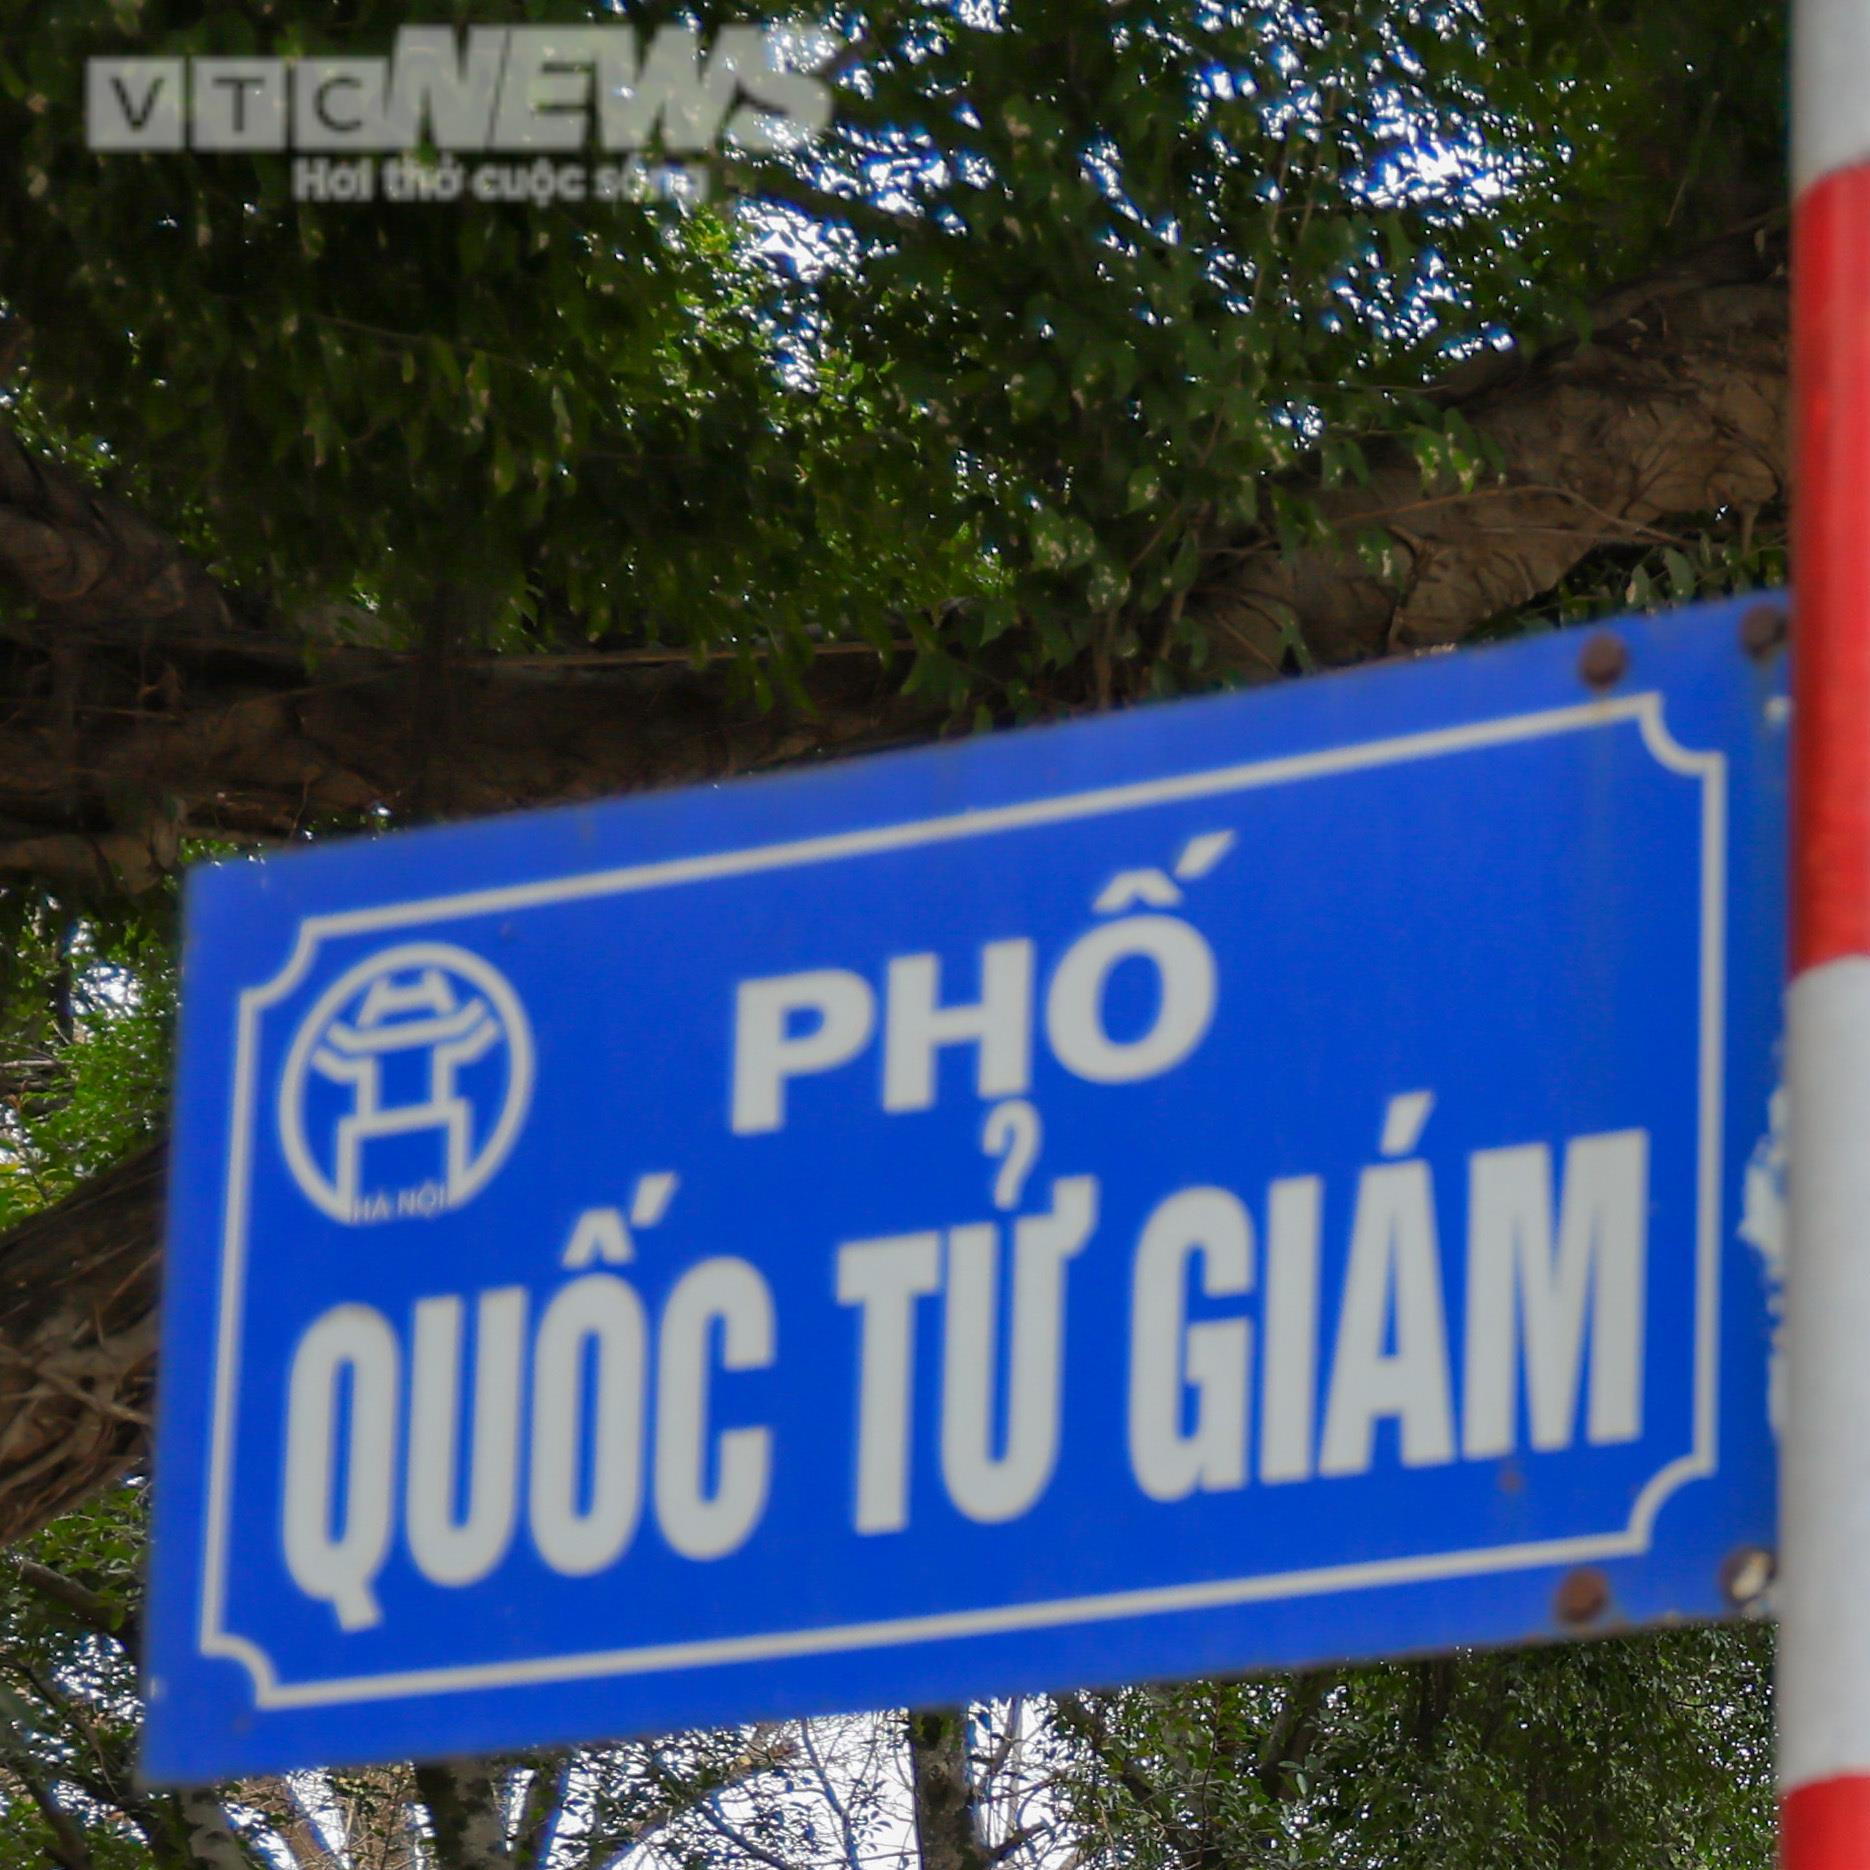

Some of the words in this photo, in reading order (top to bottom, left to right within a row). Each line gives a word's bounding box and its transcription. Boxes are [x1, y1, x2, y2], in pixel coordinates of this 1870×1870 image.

[730, 829, 1234, 1135] PHỐ
[281, 1172, 776, 1632] QUỐC
[836, 1098, 1097, 1534] TỬ
[1128, 1091, 1649, 1502] GIÁM
